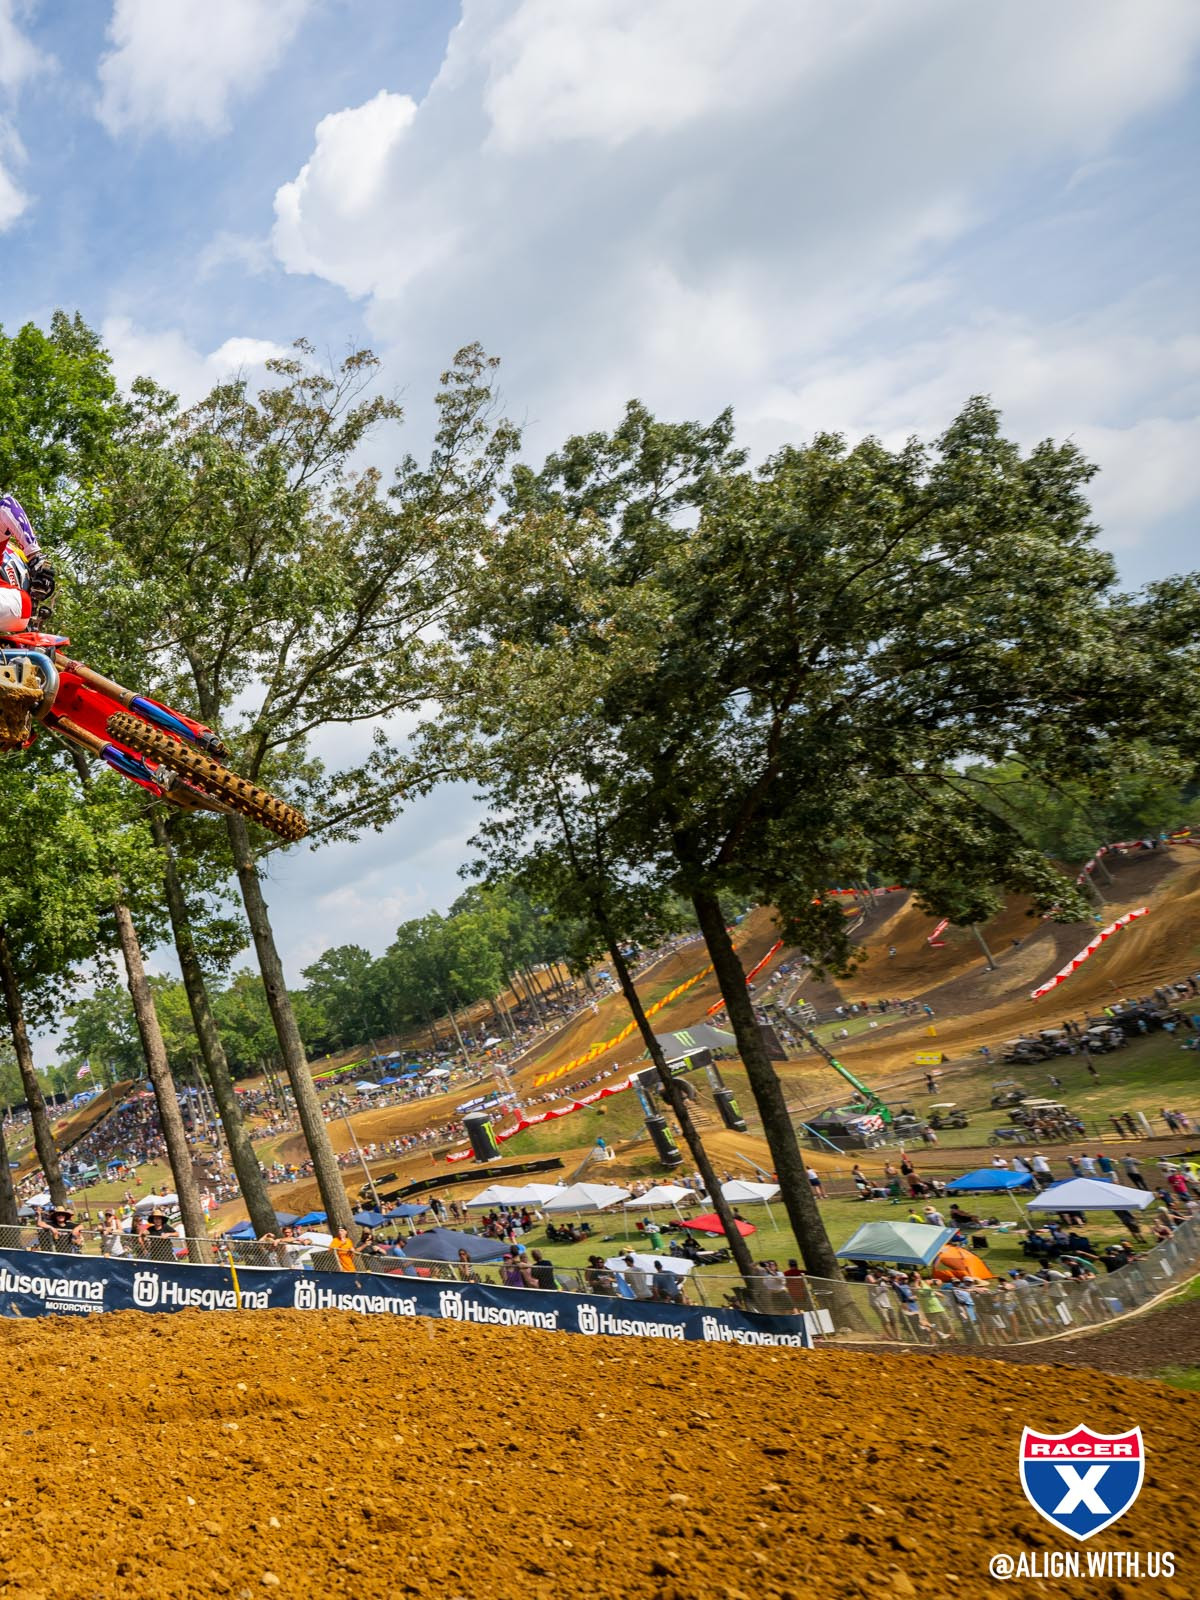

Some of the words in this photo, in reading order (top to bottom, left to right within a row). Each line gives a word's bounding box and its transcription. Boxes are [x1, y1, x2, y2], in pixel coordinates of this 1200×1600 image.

[45, 1301, 103, 1313] MOTORCYCLES
[318, 1289, 416, 1316] Husqvarna
[464, 1300, 557, 1329] Husqvarna
